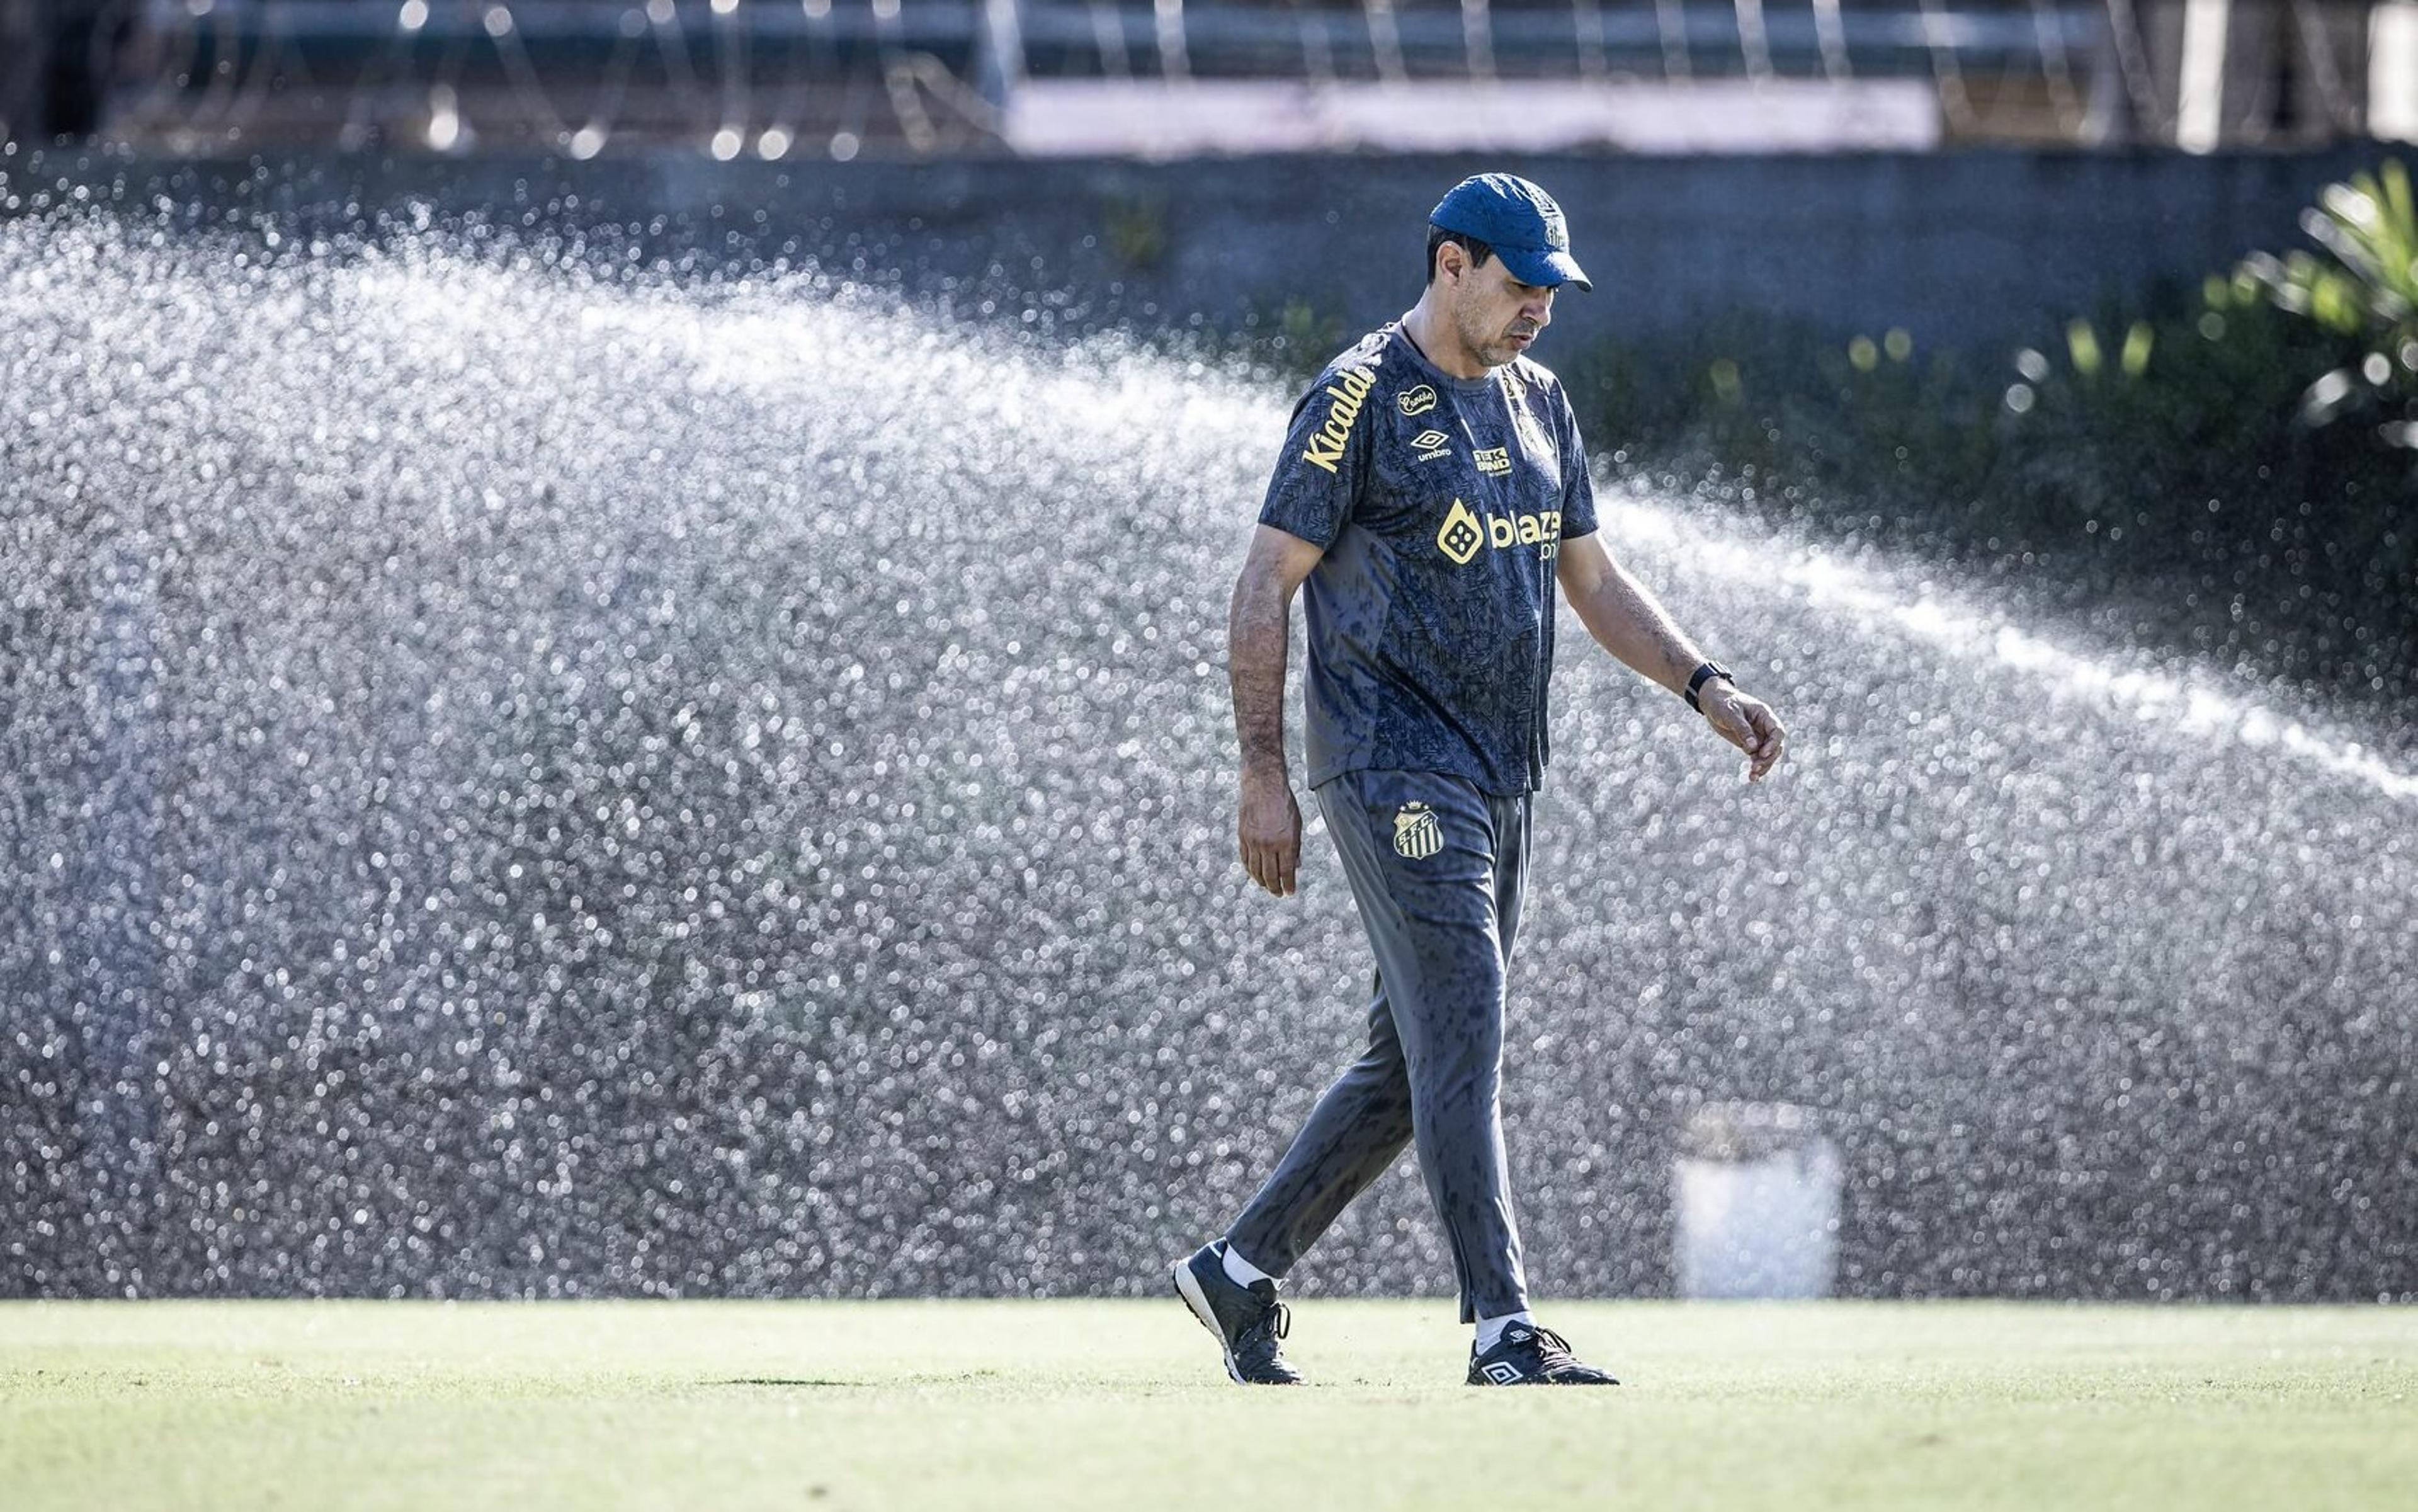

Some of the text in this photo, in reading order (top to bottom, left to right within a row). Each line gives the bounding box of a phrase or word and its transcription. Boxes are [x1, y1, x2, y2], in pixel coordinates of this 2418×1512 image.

[1302, 365, 1376, 474] Kicaldo
[1417, 448, 1451, 462] umbro
[1486, 510, 1561, 549] blaze
